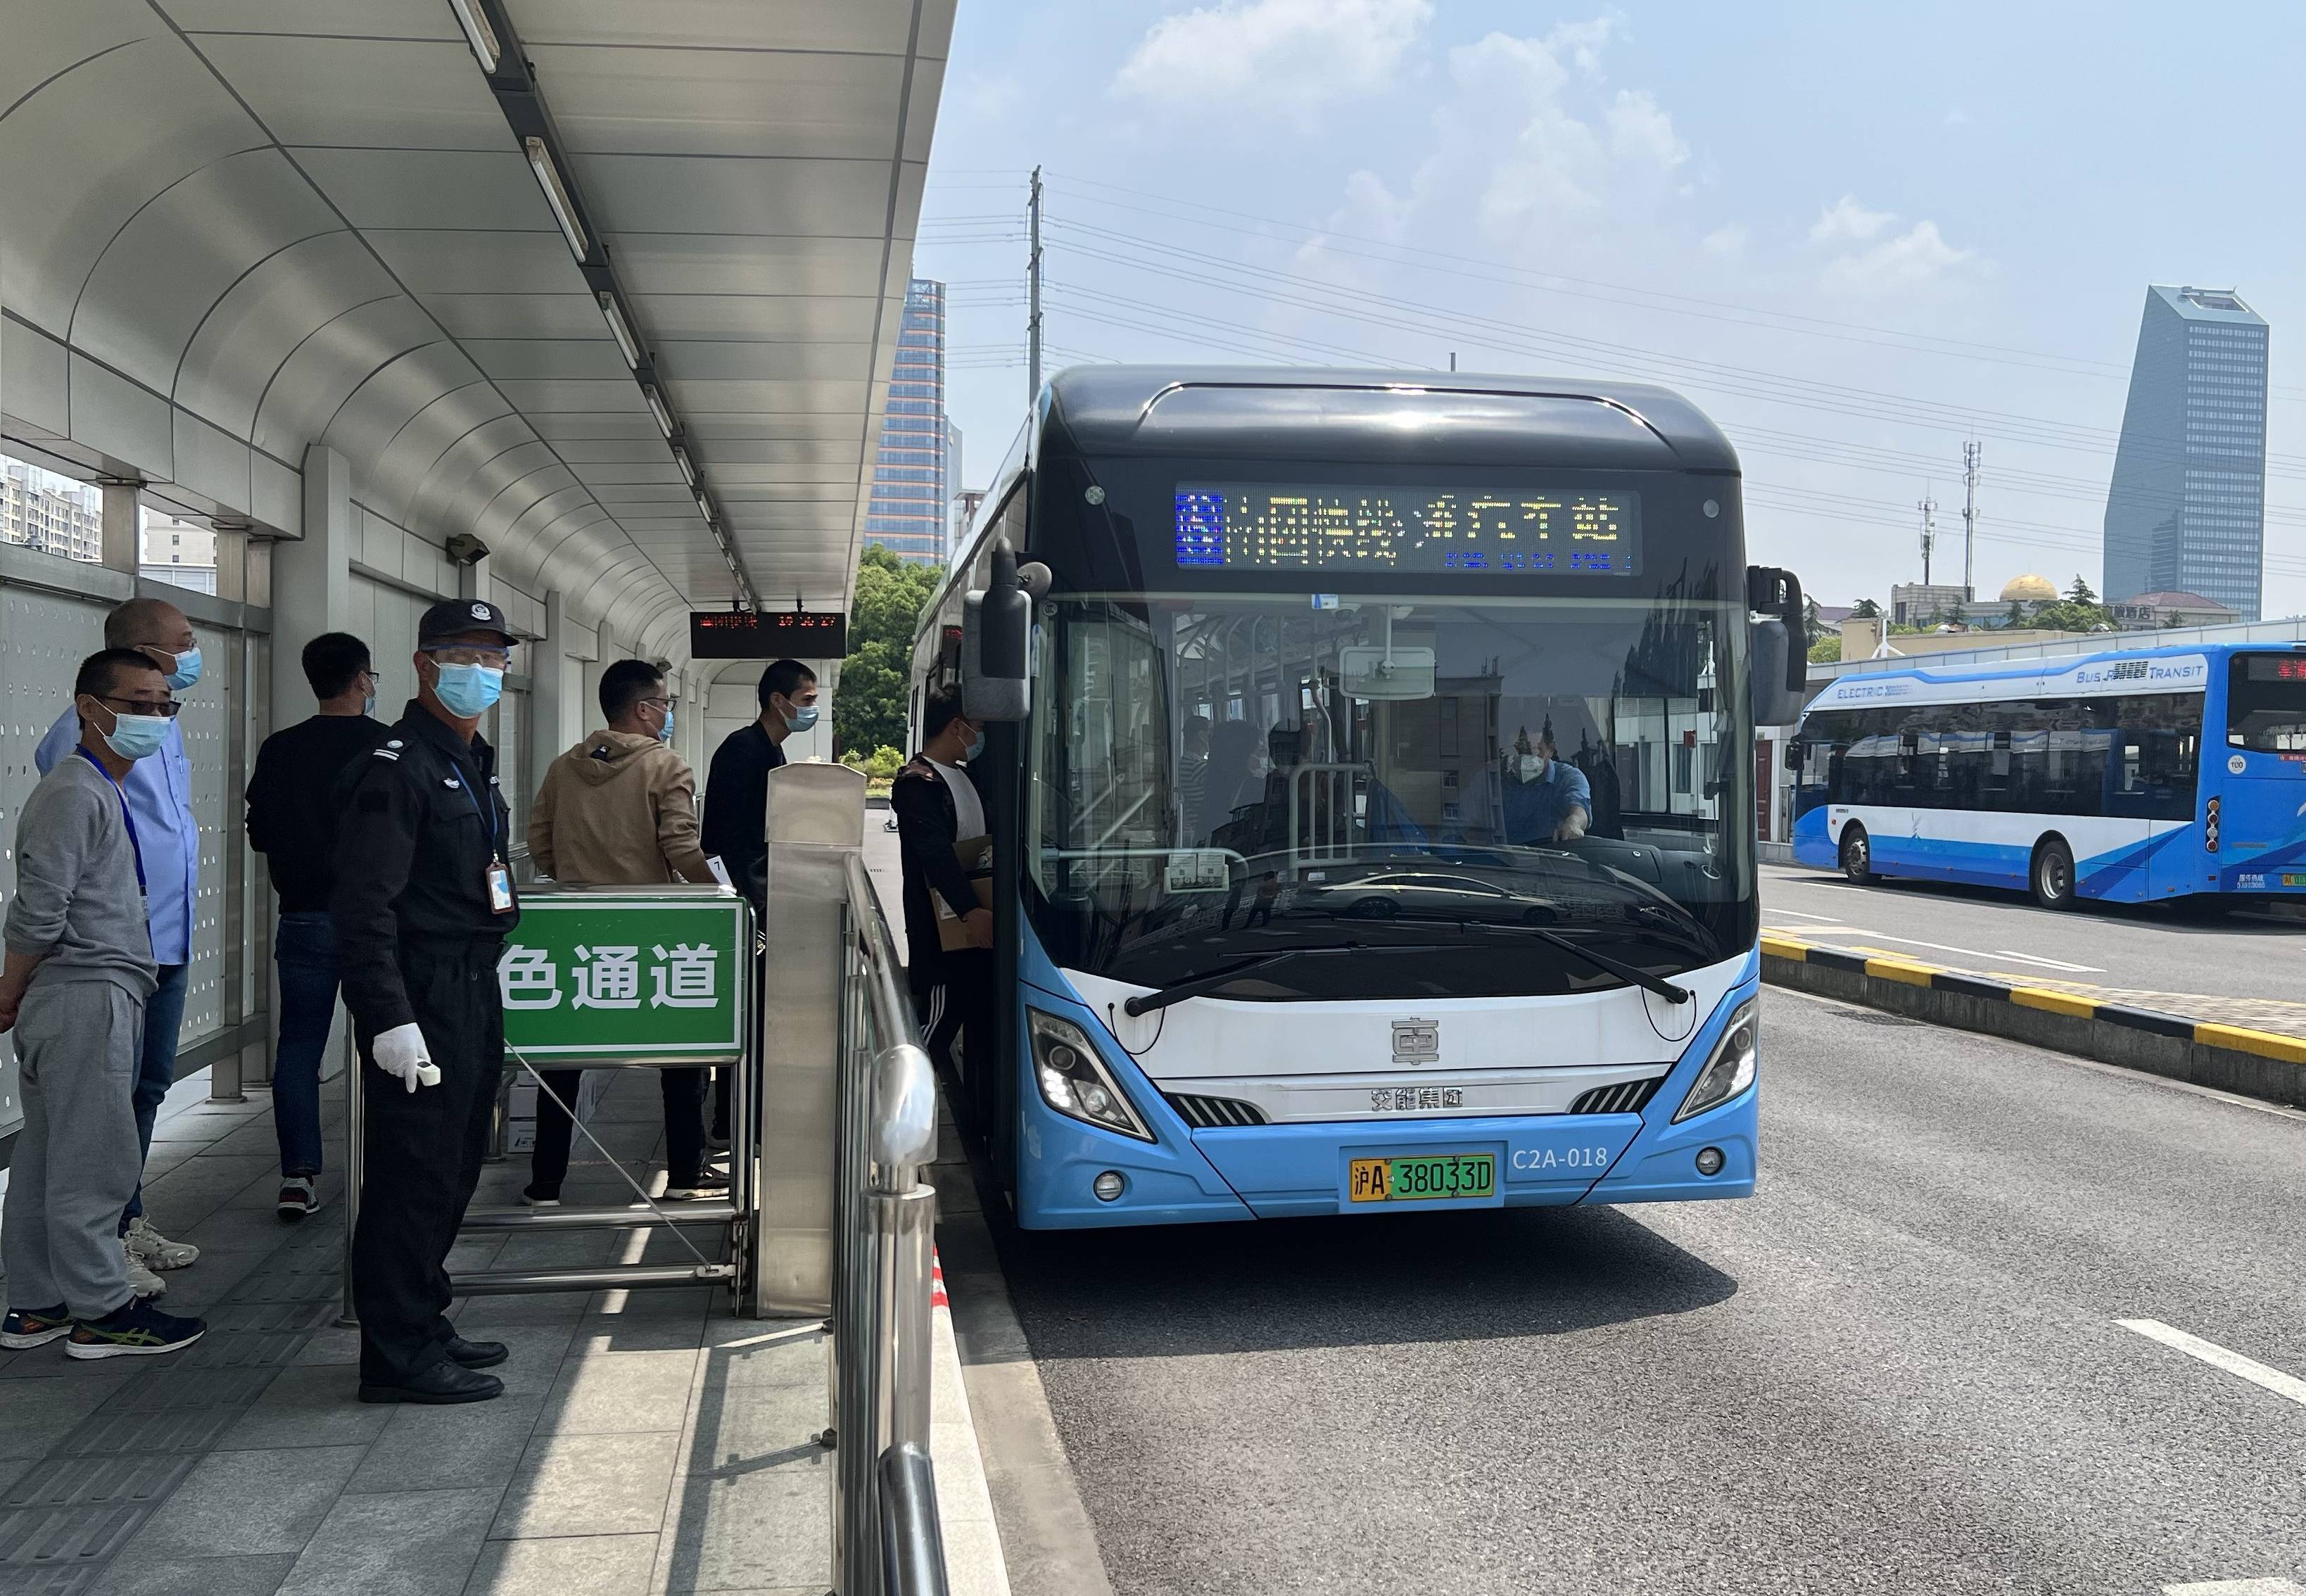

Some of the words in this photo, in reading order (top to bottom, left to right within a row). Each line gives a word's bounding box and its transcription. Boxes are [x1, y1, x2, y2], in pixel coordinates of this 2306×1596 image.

[2150, 666, 2204, 679] TRANSIT
[496, 943, 719, 1010] 色通道
[1371, 1087, 1463, 1111] 交能集团
[1513, 1147, 1607, 1170] C2A-018
